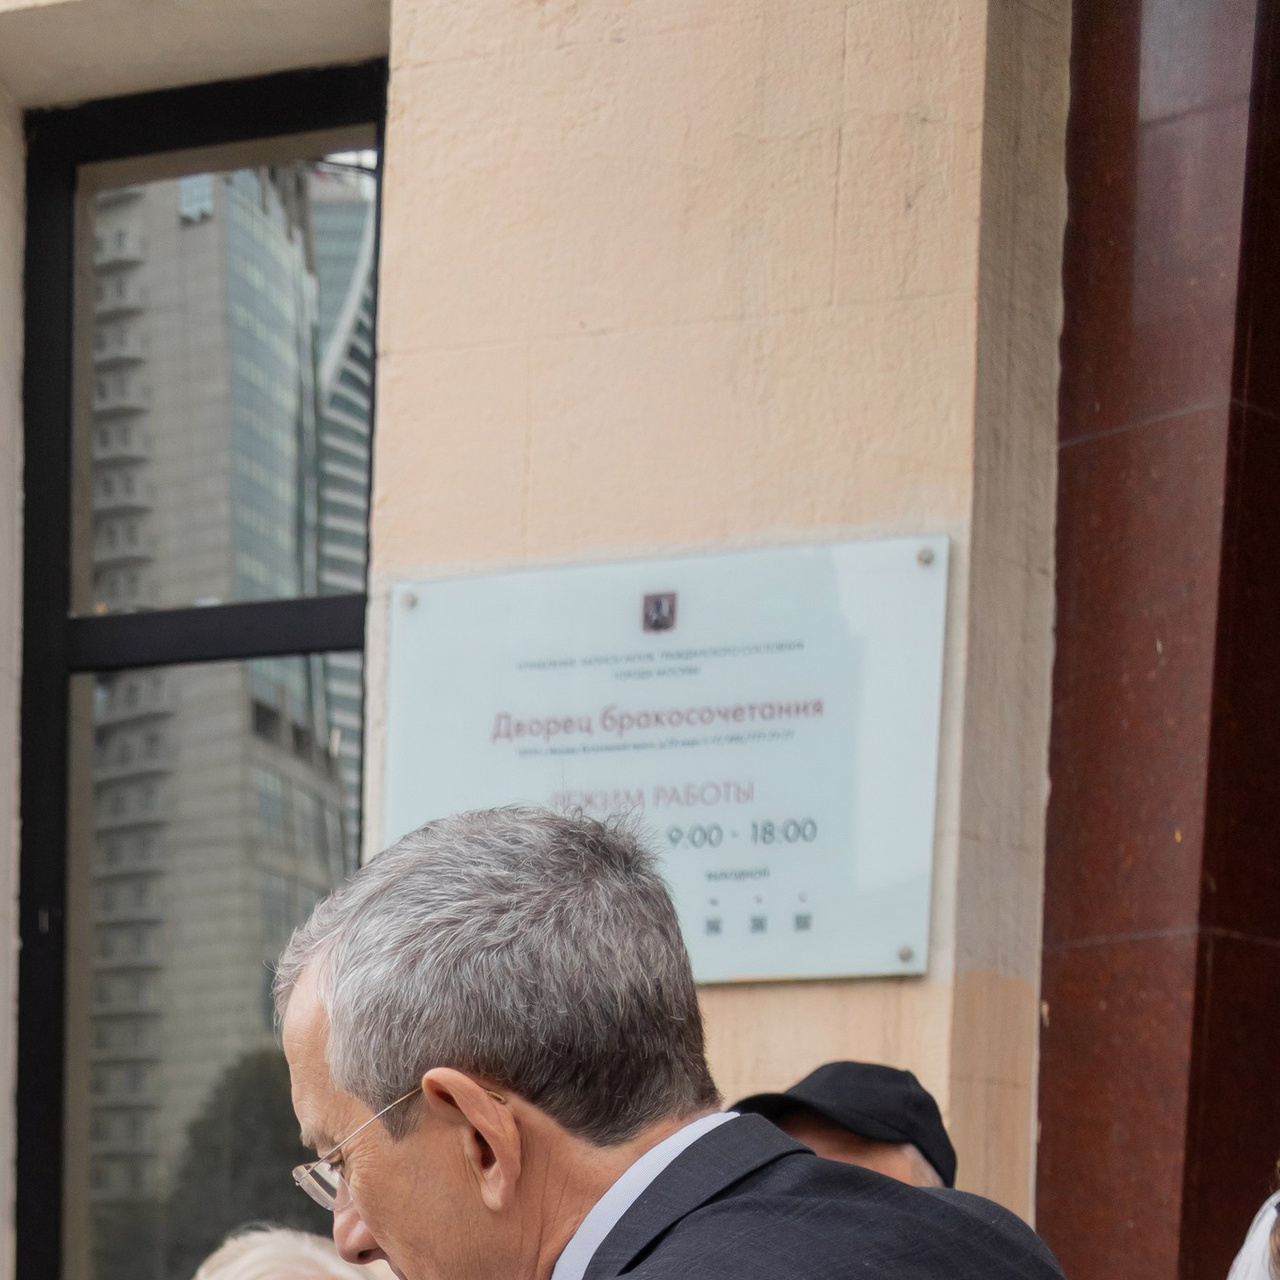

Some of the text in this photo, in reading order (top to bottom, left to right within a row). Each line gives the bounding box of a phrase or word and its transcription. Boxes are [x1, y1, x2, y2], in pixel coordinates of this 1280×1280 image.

[491, 711, 592, 744] Дворец
[600, 699, 824, 735] бракосочетания
[652, 781, 755, 808] РАБОТЫ
[750, 818, 818, 846] 18:00
